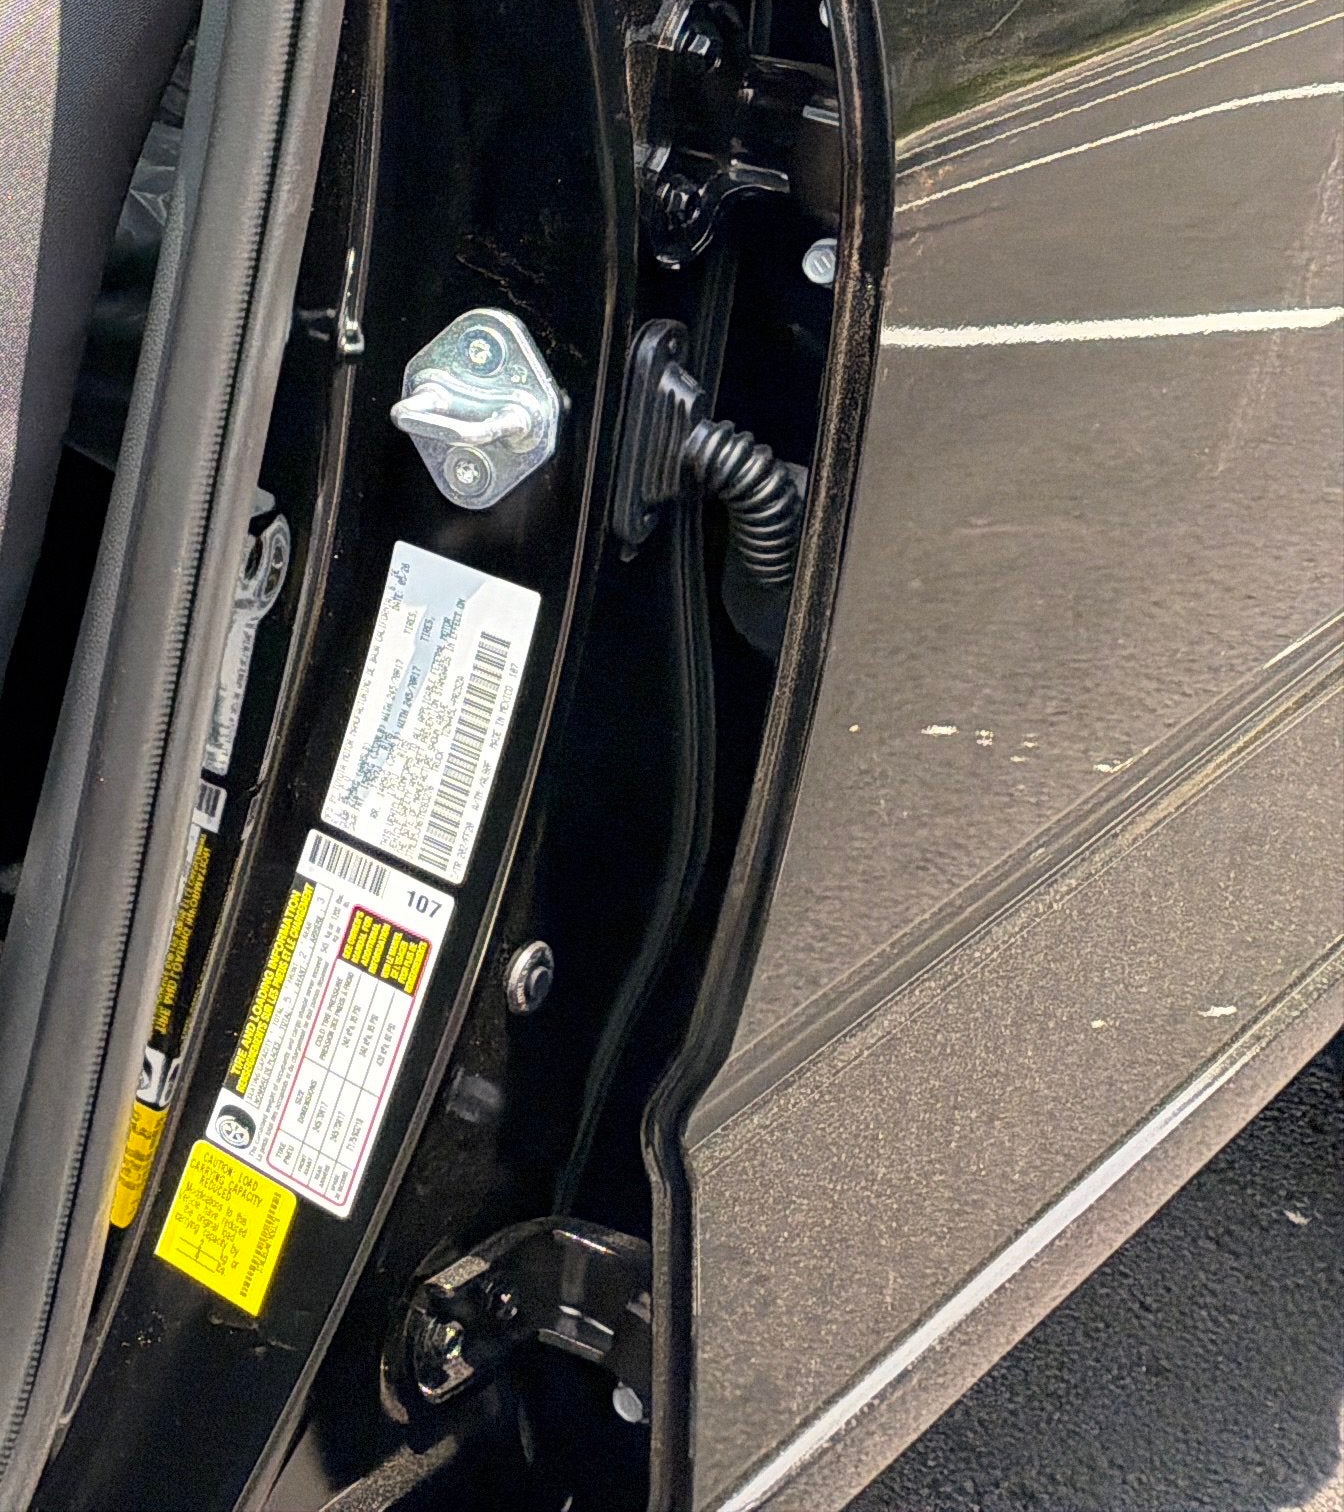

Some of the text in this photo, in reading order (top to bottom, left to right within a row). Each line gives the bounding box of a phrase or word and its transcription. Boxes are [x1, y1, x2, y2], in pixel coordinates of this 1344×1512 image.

[437, 614, 453, 642] MOTOR
[446, 609, 464, 641] EFFECT
[378, 700, 393, 723] WITH
[497, 683, 514, 715] MEXICO
[395, 706, 409, 730] WITH
[287, 881, 316, 940] CHARGEMENT
[401, 886, 443, 921] 107
[229, 888, 303, 1077] TIRE AND LOADING INFORMATION
[271, 958, 289, 989] PNEUS
[265, 985, 280, 1006] LES
[259, 1001, 275, 1023] SUR
[313, 1027, 326, 1048] COLD
[325, 975, 344, 1013] PRESSURE
[234, 1018, 269, 1094] RENSEIGNEMENTS
[197, 1173, 234, 1203] REDUCED
[225, 1178, 264, 1209] CAPACITY
[236, 1171, 260, 1193] LOAD
